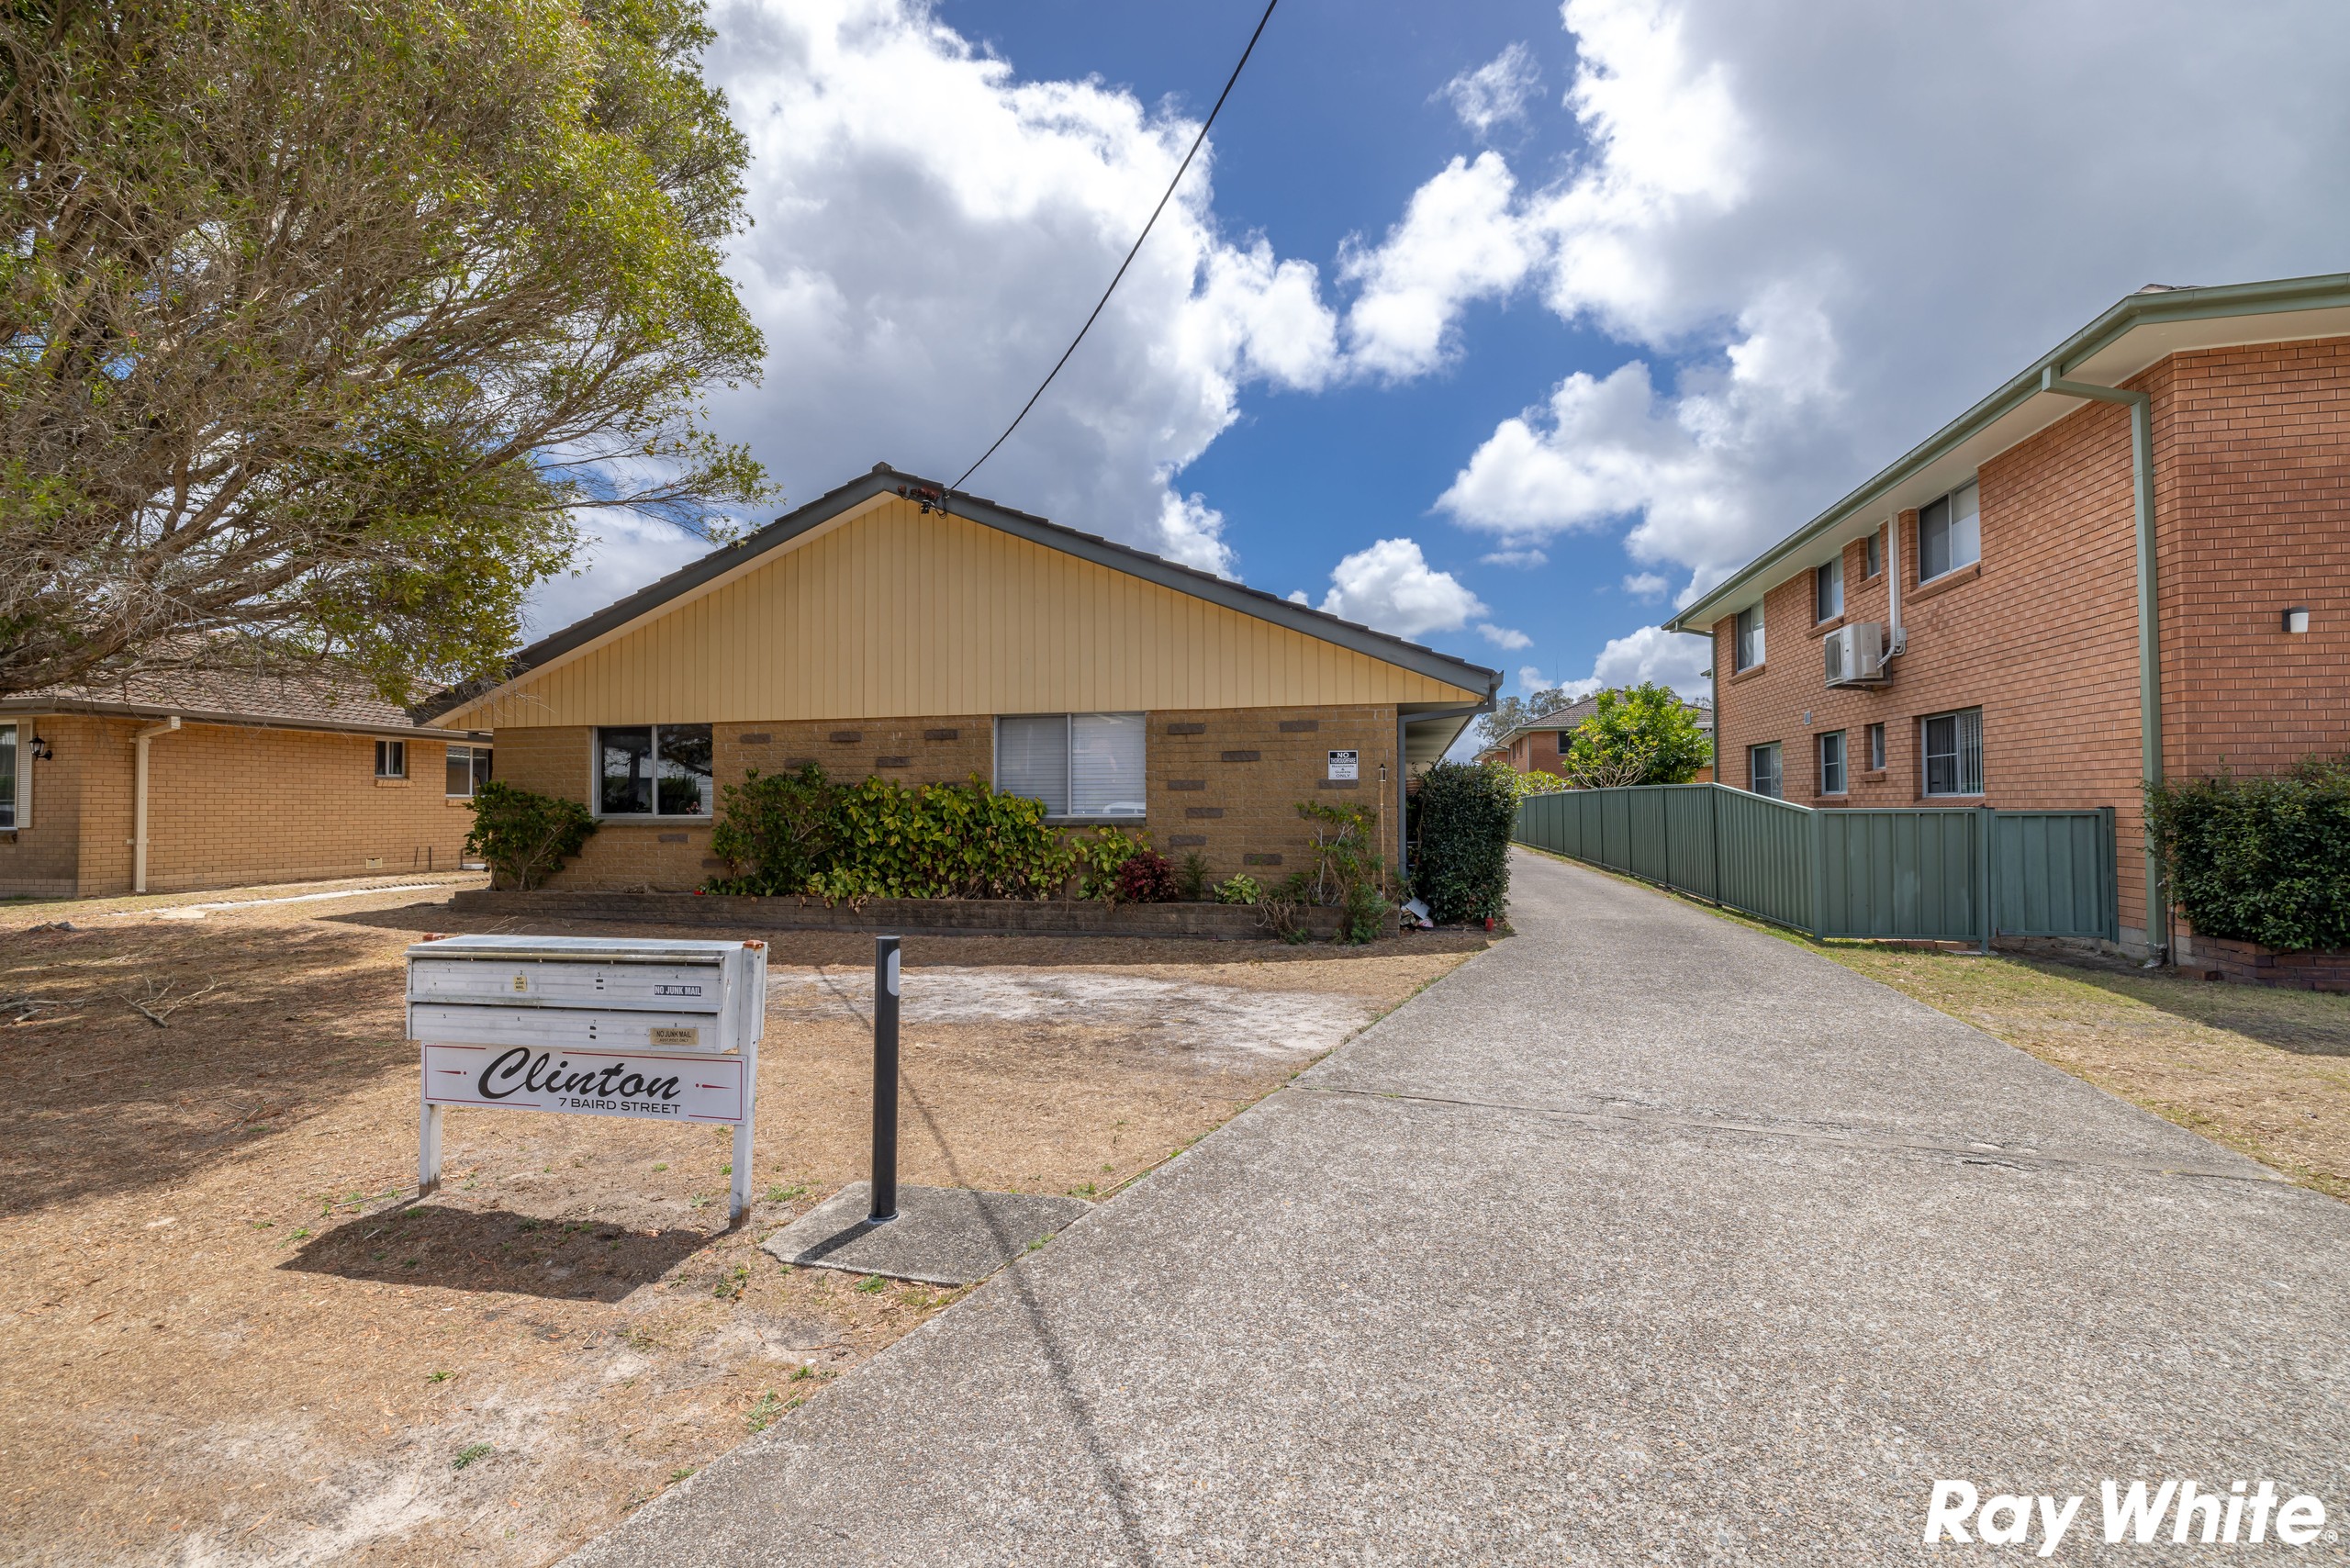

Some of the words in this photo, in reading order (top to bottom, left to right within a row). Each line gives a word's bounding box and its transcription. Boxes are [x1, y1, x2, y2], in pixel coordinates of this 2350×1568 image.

[655, 986, 664, 994] NO
[666, 986, 685, 995] JUNK
[685, 987, 701, 995] MAIL
[477, 1047, 681, 1100] Clinton
[558, 1097, 567, 1107] 7
[571, 1098, 617, 1111] BAIRD
[621, 1101, 681, 1114] STREET
